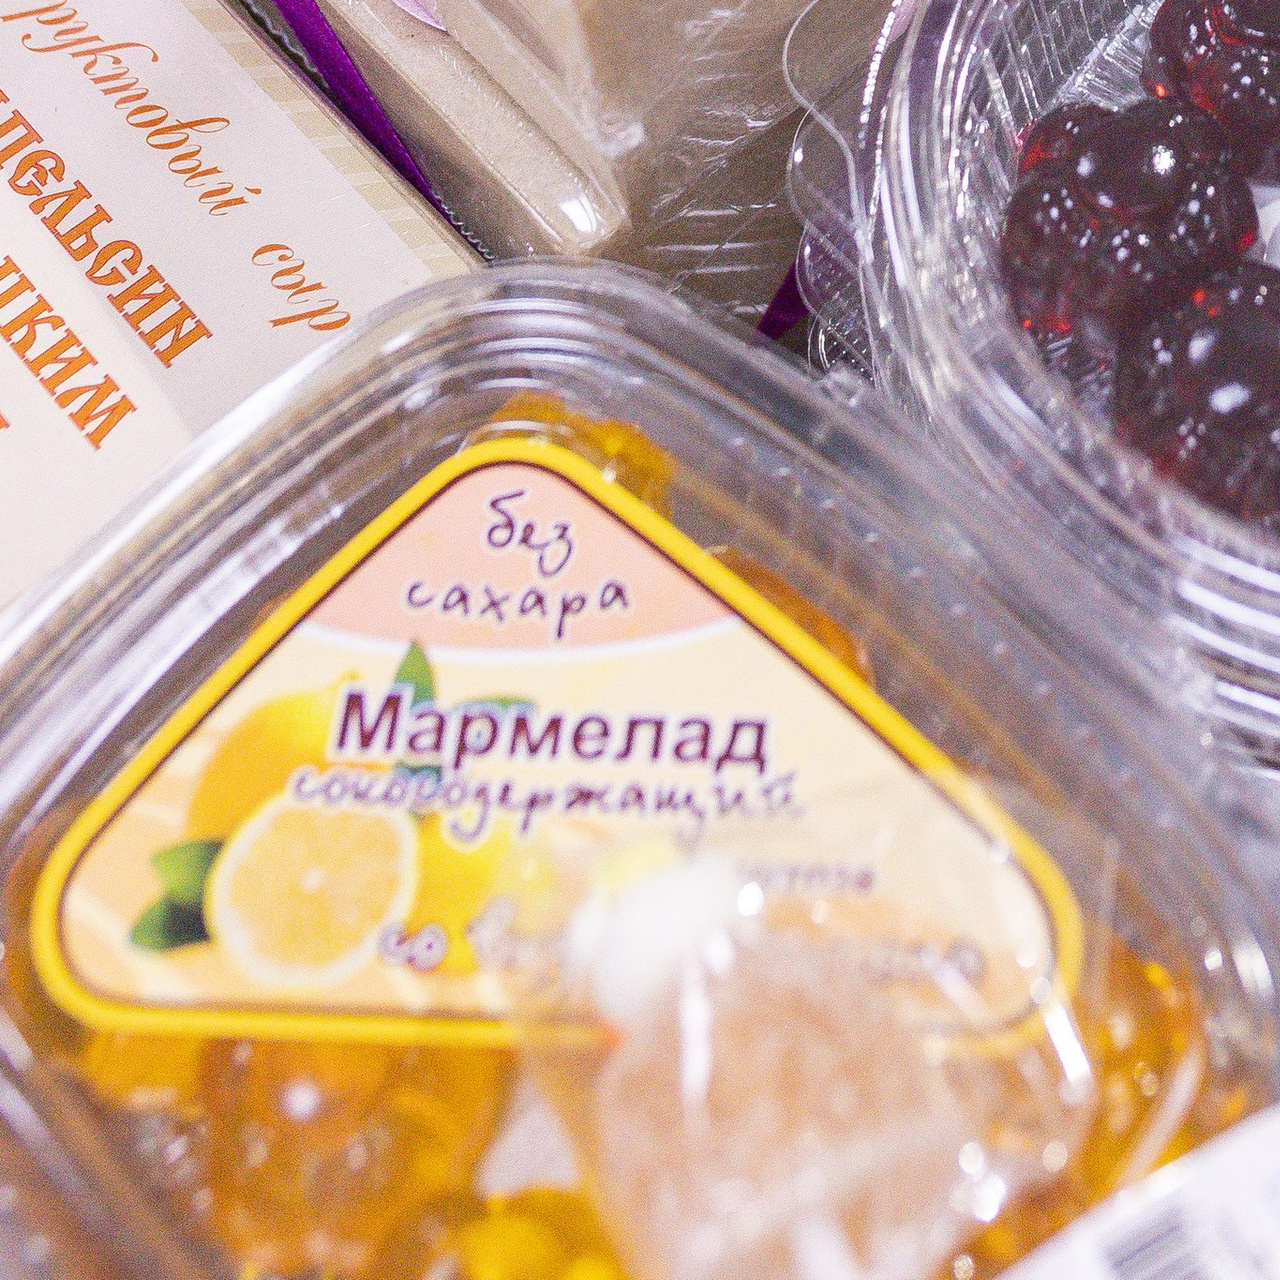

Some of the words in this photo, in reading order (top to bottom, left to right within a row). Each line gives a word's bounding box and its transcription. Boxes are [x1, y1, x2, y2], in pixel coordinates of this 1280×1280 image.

[0, 88, 214, 370] ПЕЛЬСИН
[250, 241, 353, 334] сыр
[484, 488, 578, 579] без
[404, 573, 632, 639] сахара
[330, 688, 771, 773] Мармелад
